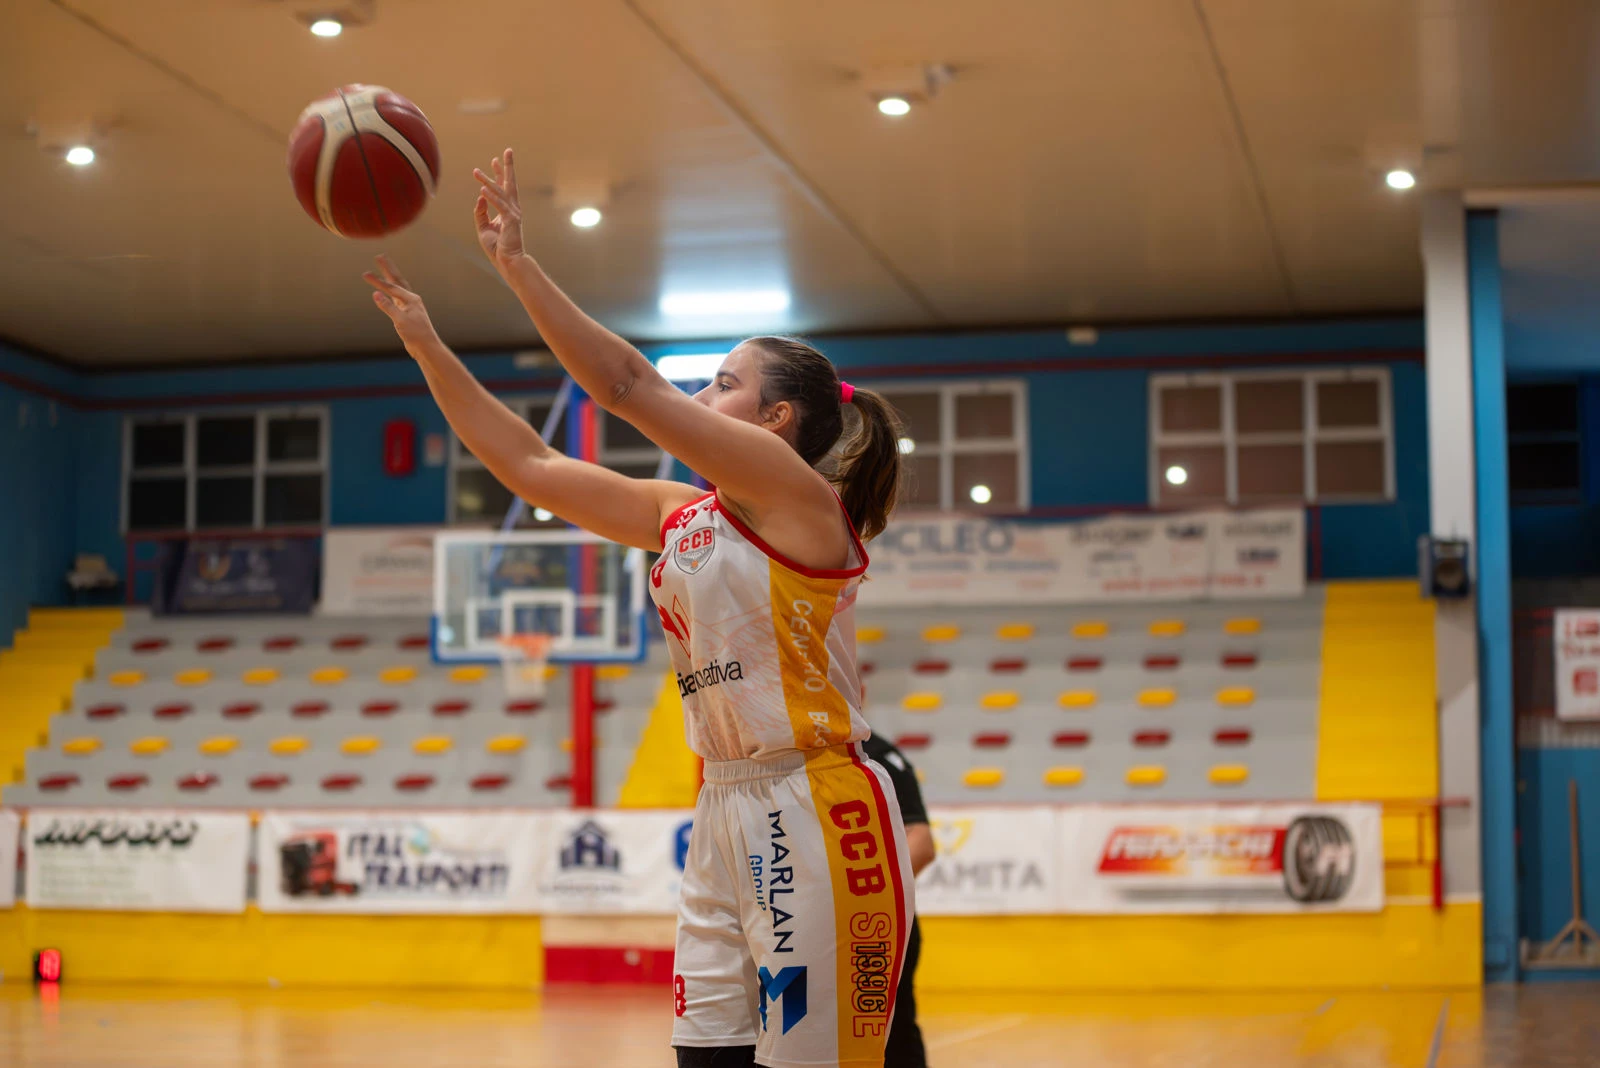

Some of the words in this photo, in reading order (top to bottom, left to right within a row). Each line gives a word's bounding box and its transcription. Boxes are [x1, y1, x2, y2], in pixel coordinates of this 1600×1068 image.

[679, 529, 713, 554] CCB
[748, 854, 767, 912] GROUP
[767, 809, 795, 953] MARLAN
[829, 799, 886, 897] CCB
[849, 911, 892, 1037] SINCE
